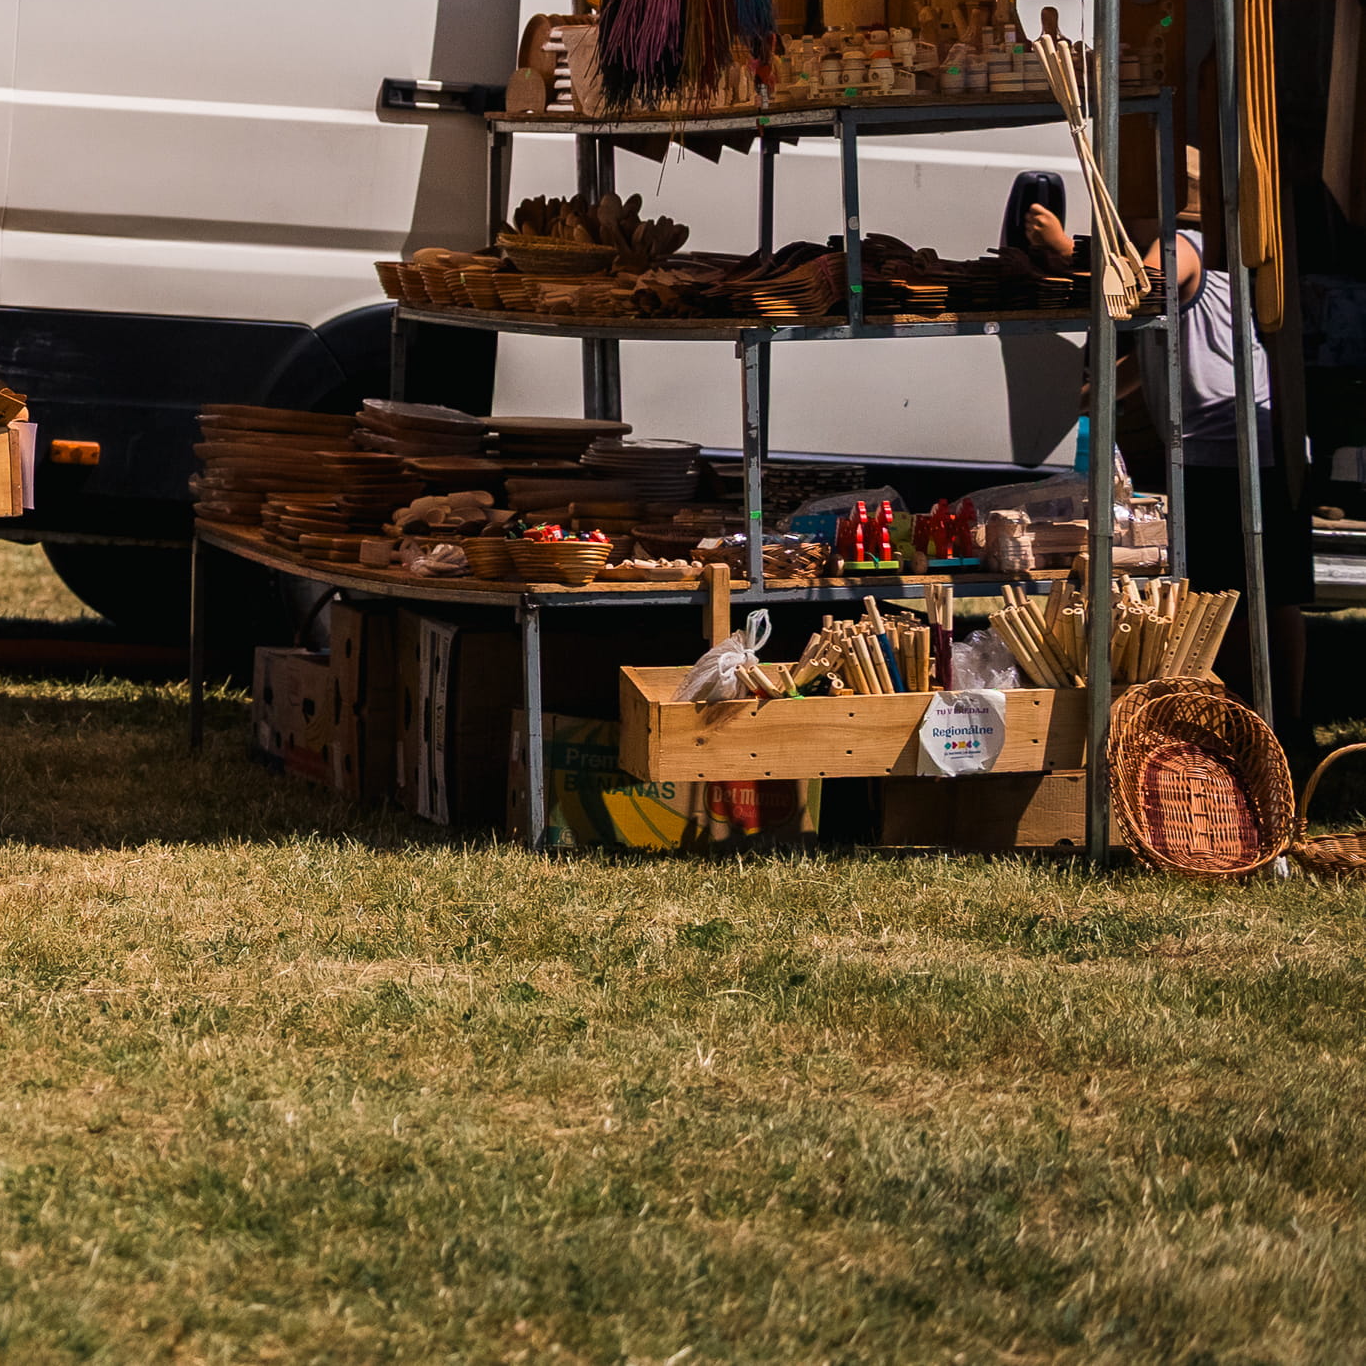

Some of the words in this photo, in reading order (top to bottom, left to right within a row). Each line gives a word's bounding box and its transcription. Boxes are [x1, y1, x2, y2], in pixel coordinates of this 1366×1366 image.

[932, 725, 994, 738] Regionálne
[565, 747, 618, 768] Prem
[564, 770, 676, 800] BNANAS
